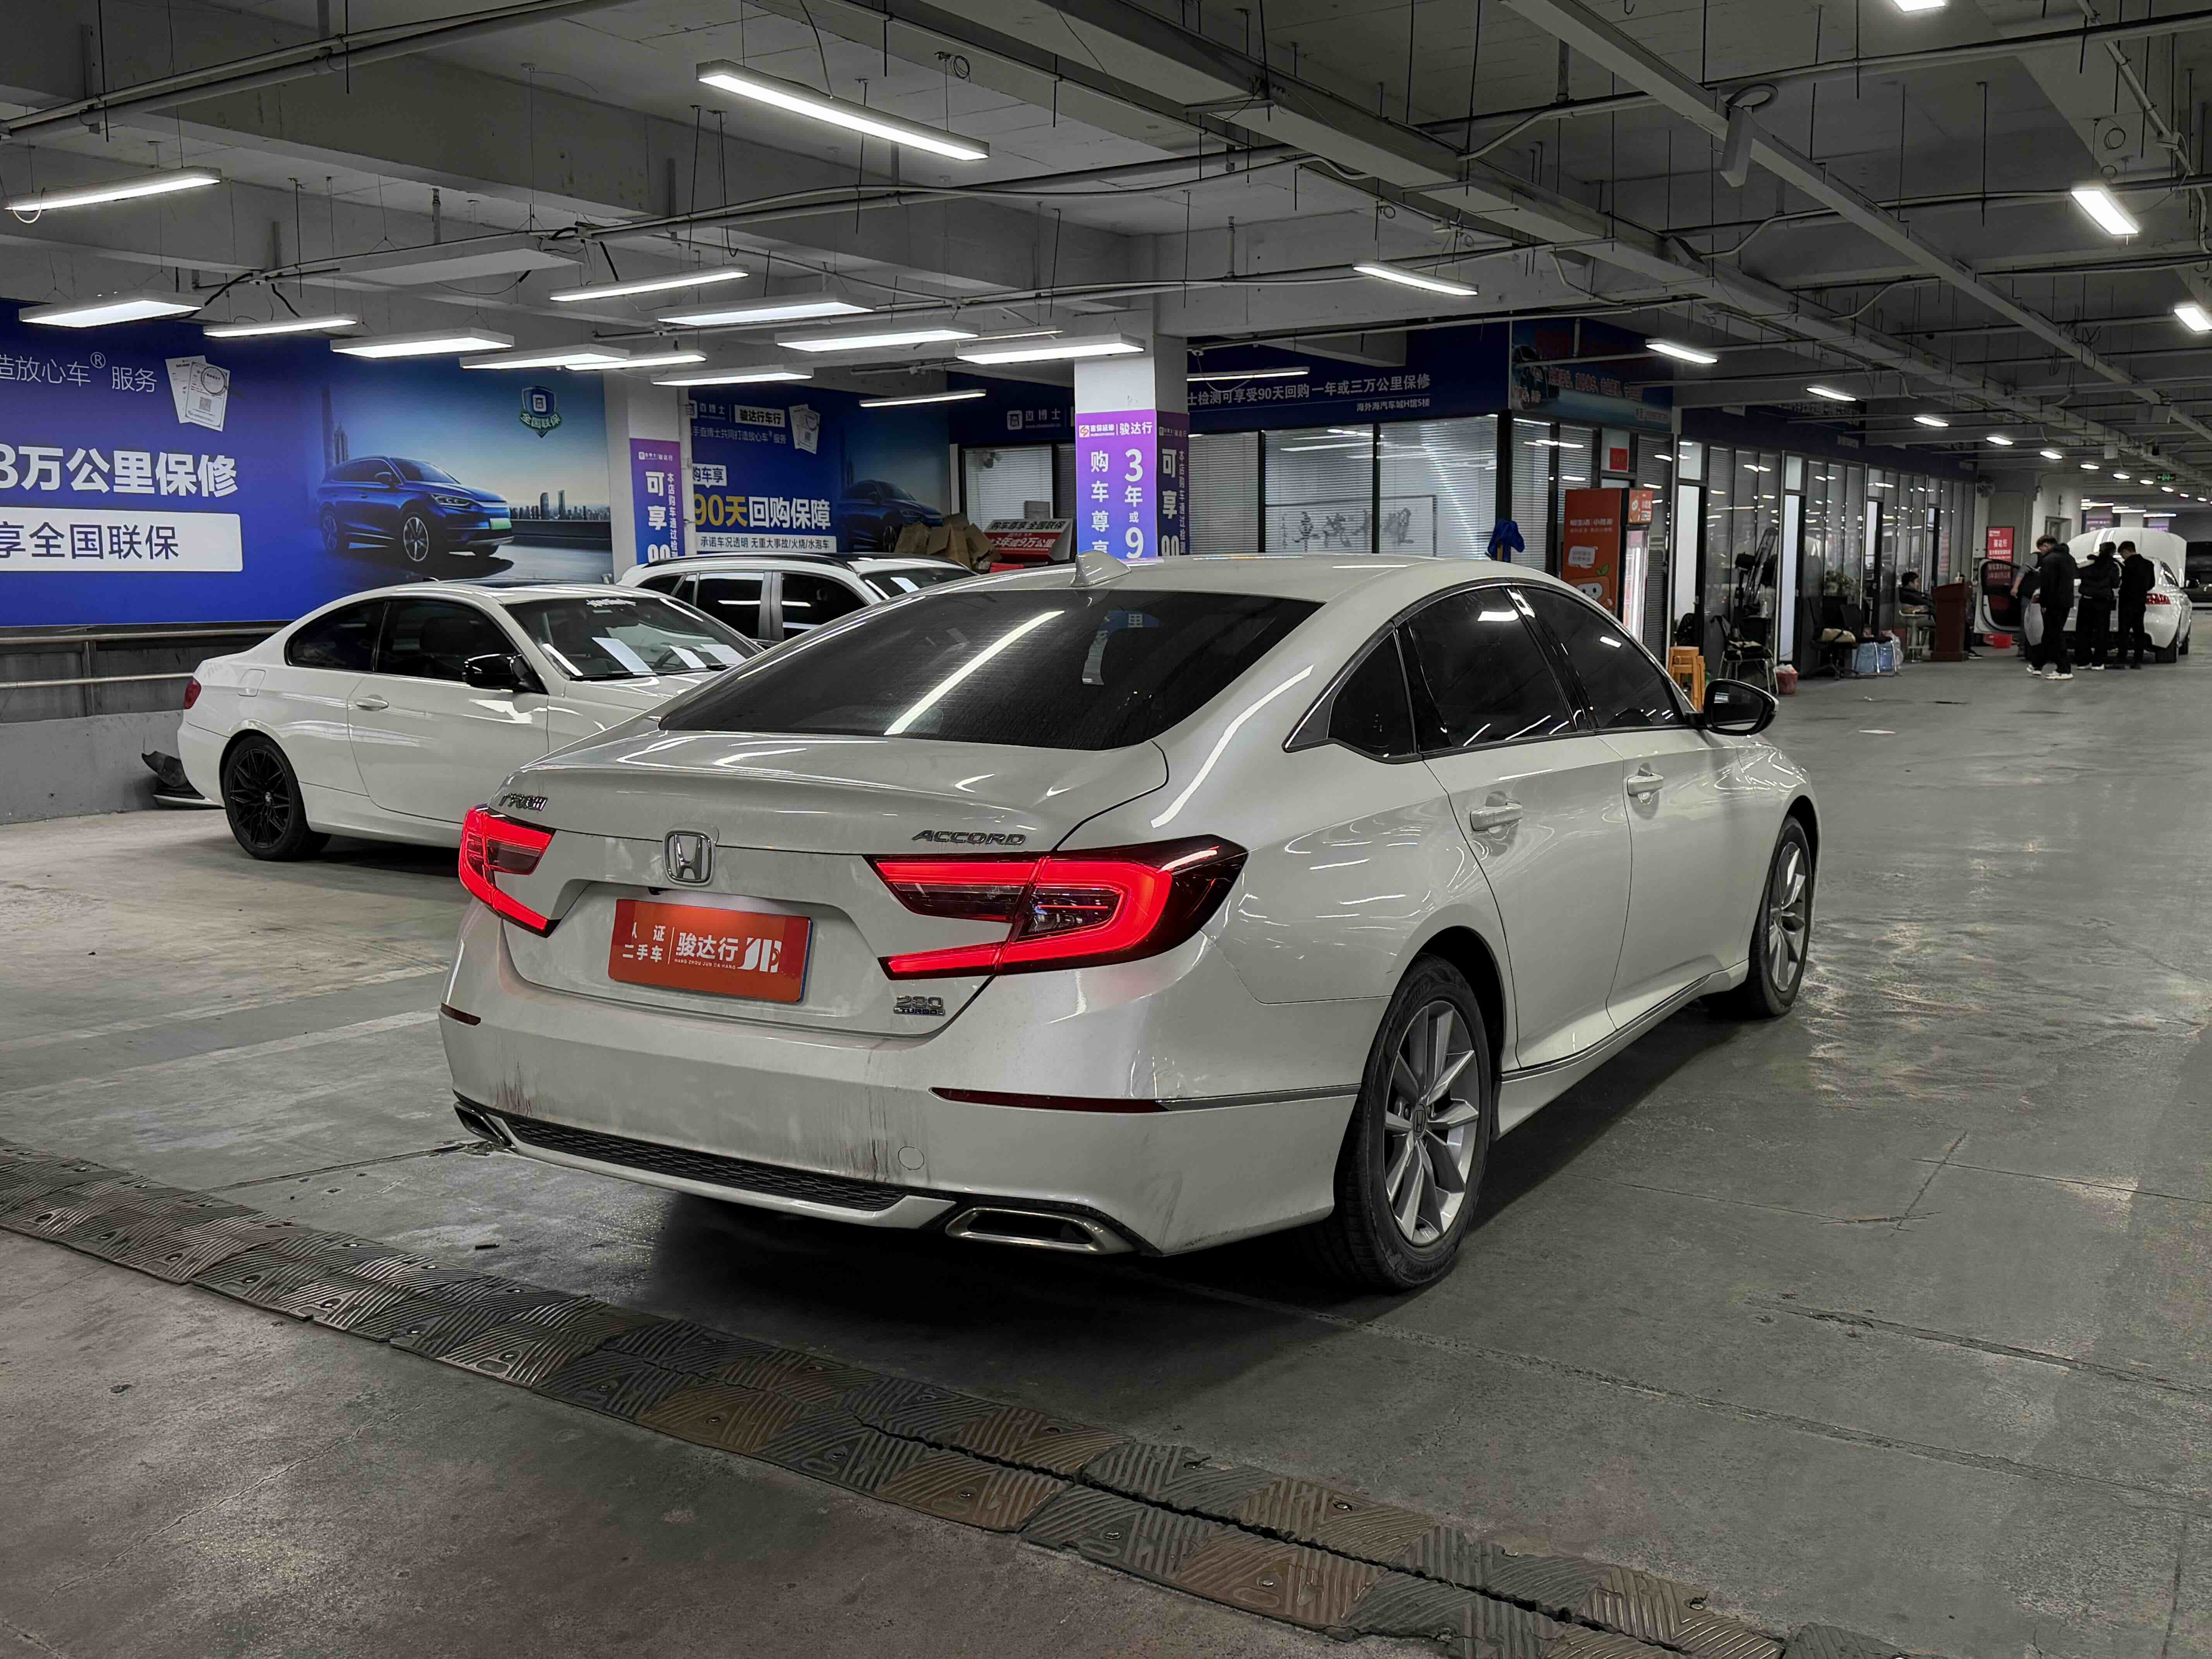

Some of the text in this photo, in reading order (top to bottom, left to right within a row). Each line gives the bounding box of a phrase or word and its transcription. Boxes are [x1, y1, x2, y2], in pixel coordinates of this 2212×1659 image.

[112, 366, 157, 393] 服务
[1312, 373, 1431, 396] 一年或三万公里保修
[520, 412, 562, 429] 全国联保
[740, 409, 781, 424] 骏达行车行
[1119, 422, 1153, 436] 骏达行
[694, 493, 831, 530] 90天回购保障
[0, 521, 179, 560] 享全国联保
[701, 536, 749, 548] 承诺车况透明
[911, 830, 1026, 845] ACCORD
[622, 944, 663, 963] 二手车
[676, 932, 738, 962] 骏达行
